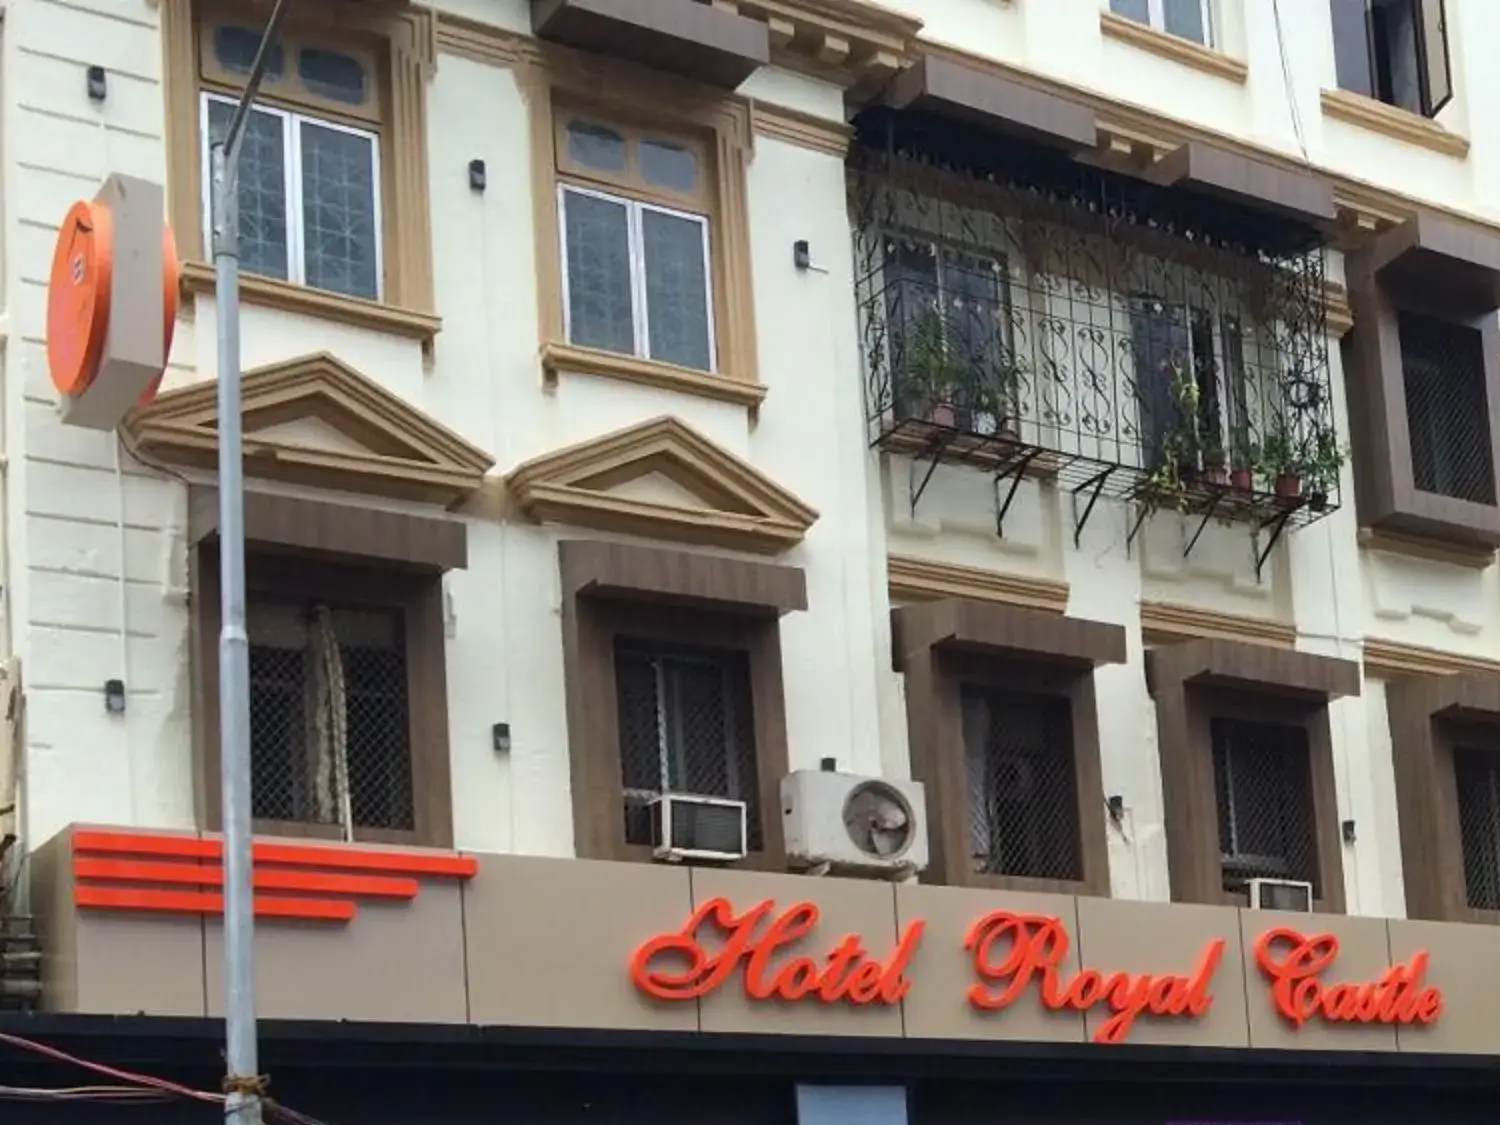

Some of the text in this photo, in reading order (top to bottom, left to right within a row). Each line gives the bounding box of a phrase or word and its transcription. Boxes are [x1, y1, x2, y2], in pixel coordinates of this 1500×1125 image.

[631, 897, 1442, 1043] Hotel Royal Castle
